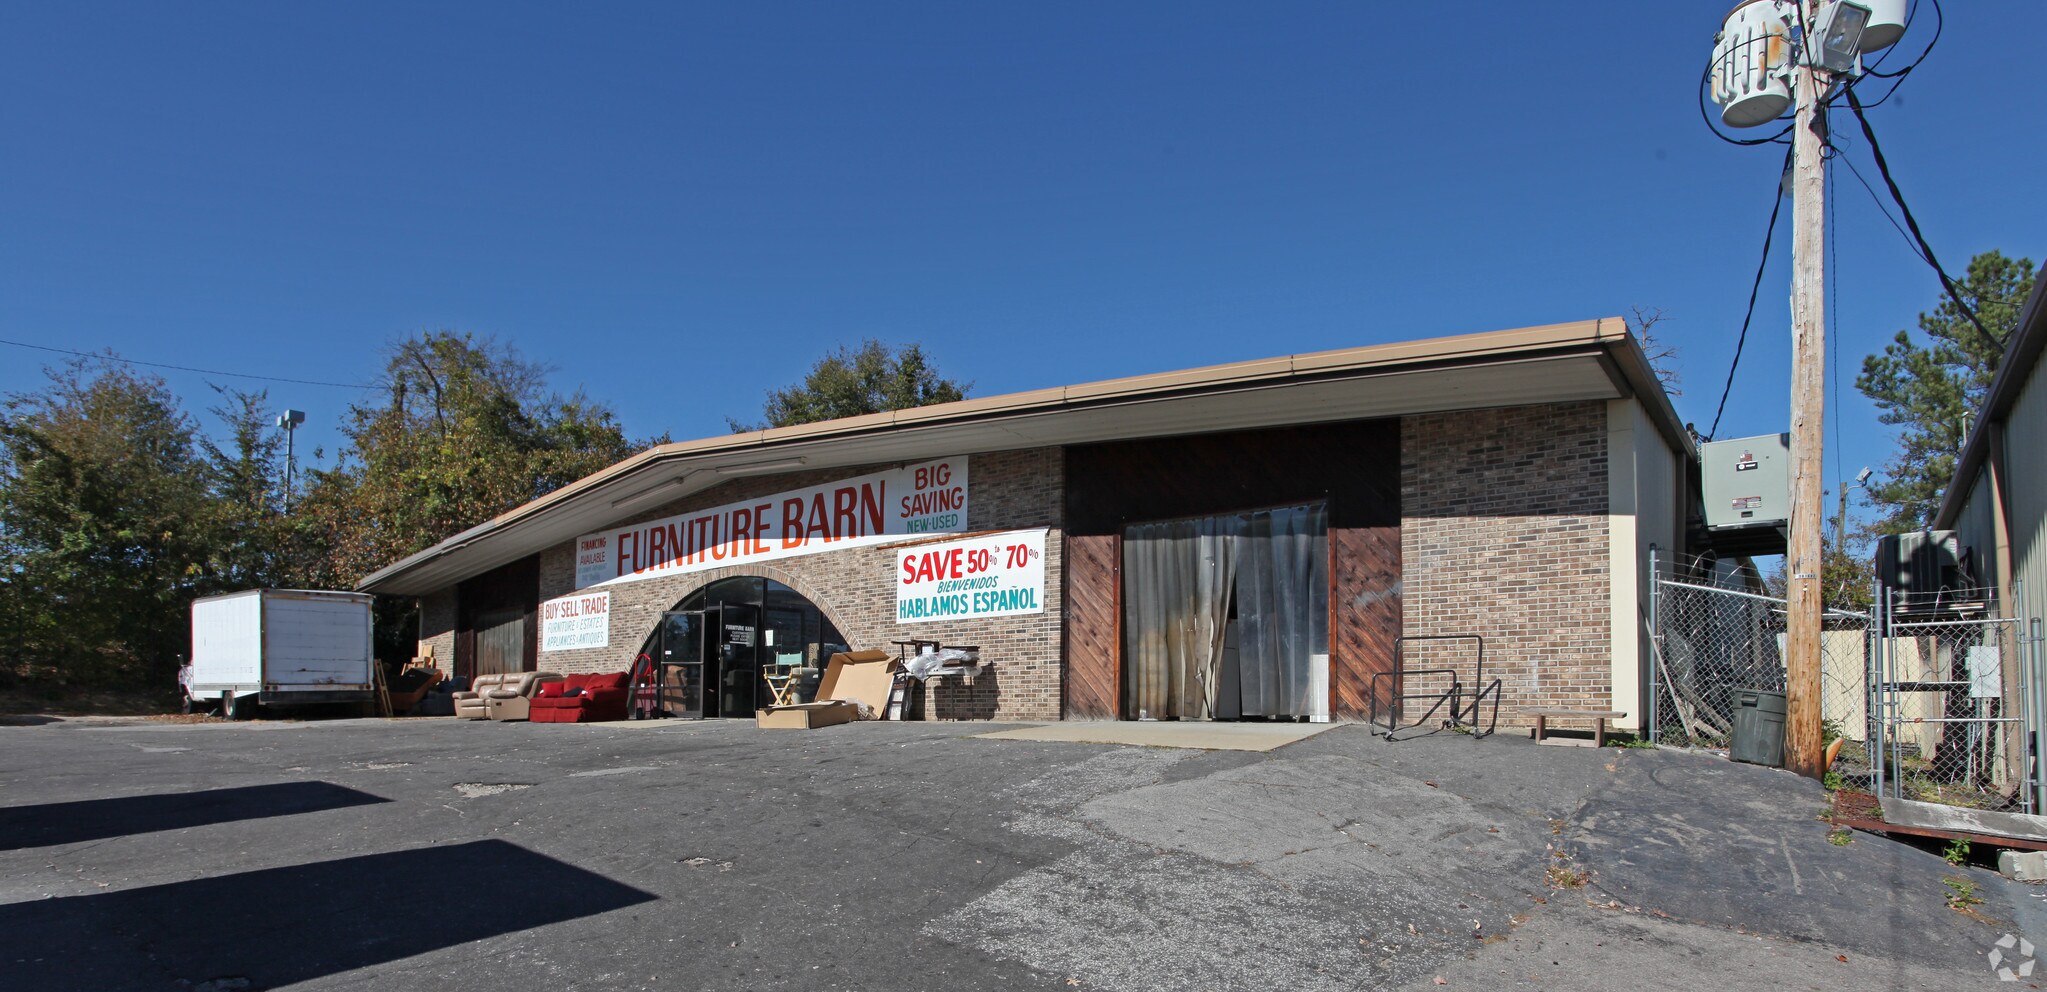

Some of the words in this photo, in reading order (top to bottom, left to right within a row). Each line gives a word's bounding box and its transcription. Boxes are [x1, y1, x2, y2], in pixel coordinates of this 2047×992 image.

[915, 463, 951, 491] BIG
[901, 487, 964, 518] SAVING
[617, 503, 772, 577] FURNITURE
[782, 480, 885, 549] BARN
[581, 537, 607, 551] FINANCING
[580, 551, 605, 565] AVAILABLE
[903, 548, 963, 585] SAVE
[1006, 543, 1039, 569] 70%
[937, 575, 998, 593] BIENVENIDOS
[899, 594, 968, 619] HABLAMOS
[973, 585, 1037, 613] ESPAÑOL
[548, 620, 575, 634] FURNITURE
[580, 616, 604, 630] ESTATES
[547, 634, 576, 647] APPLIANCES
[579, 631, 604, 646] ANTIQUES
